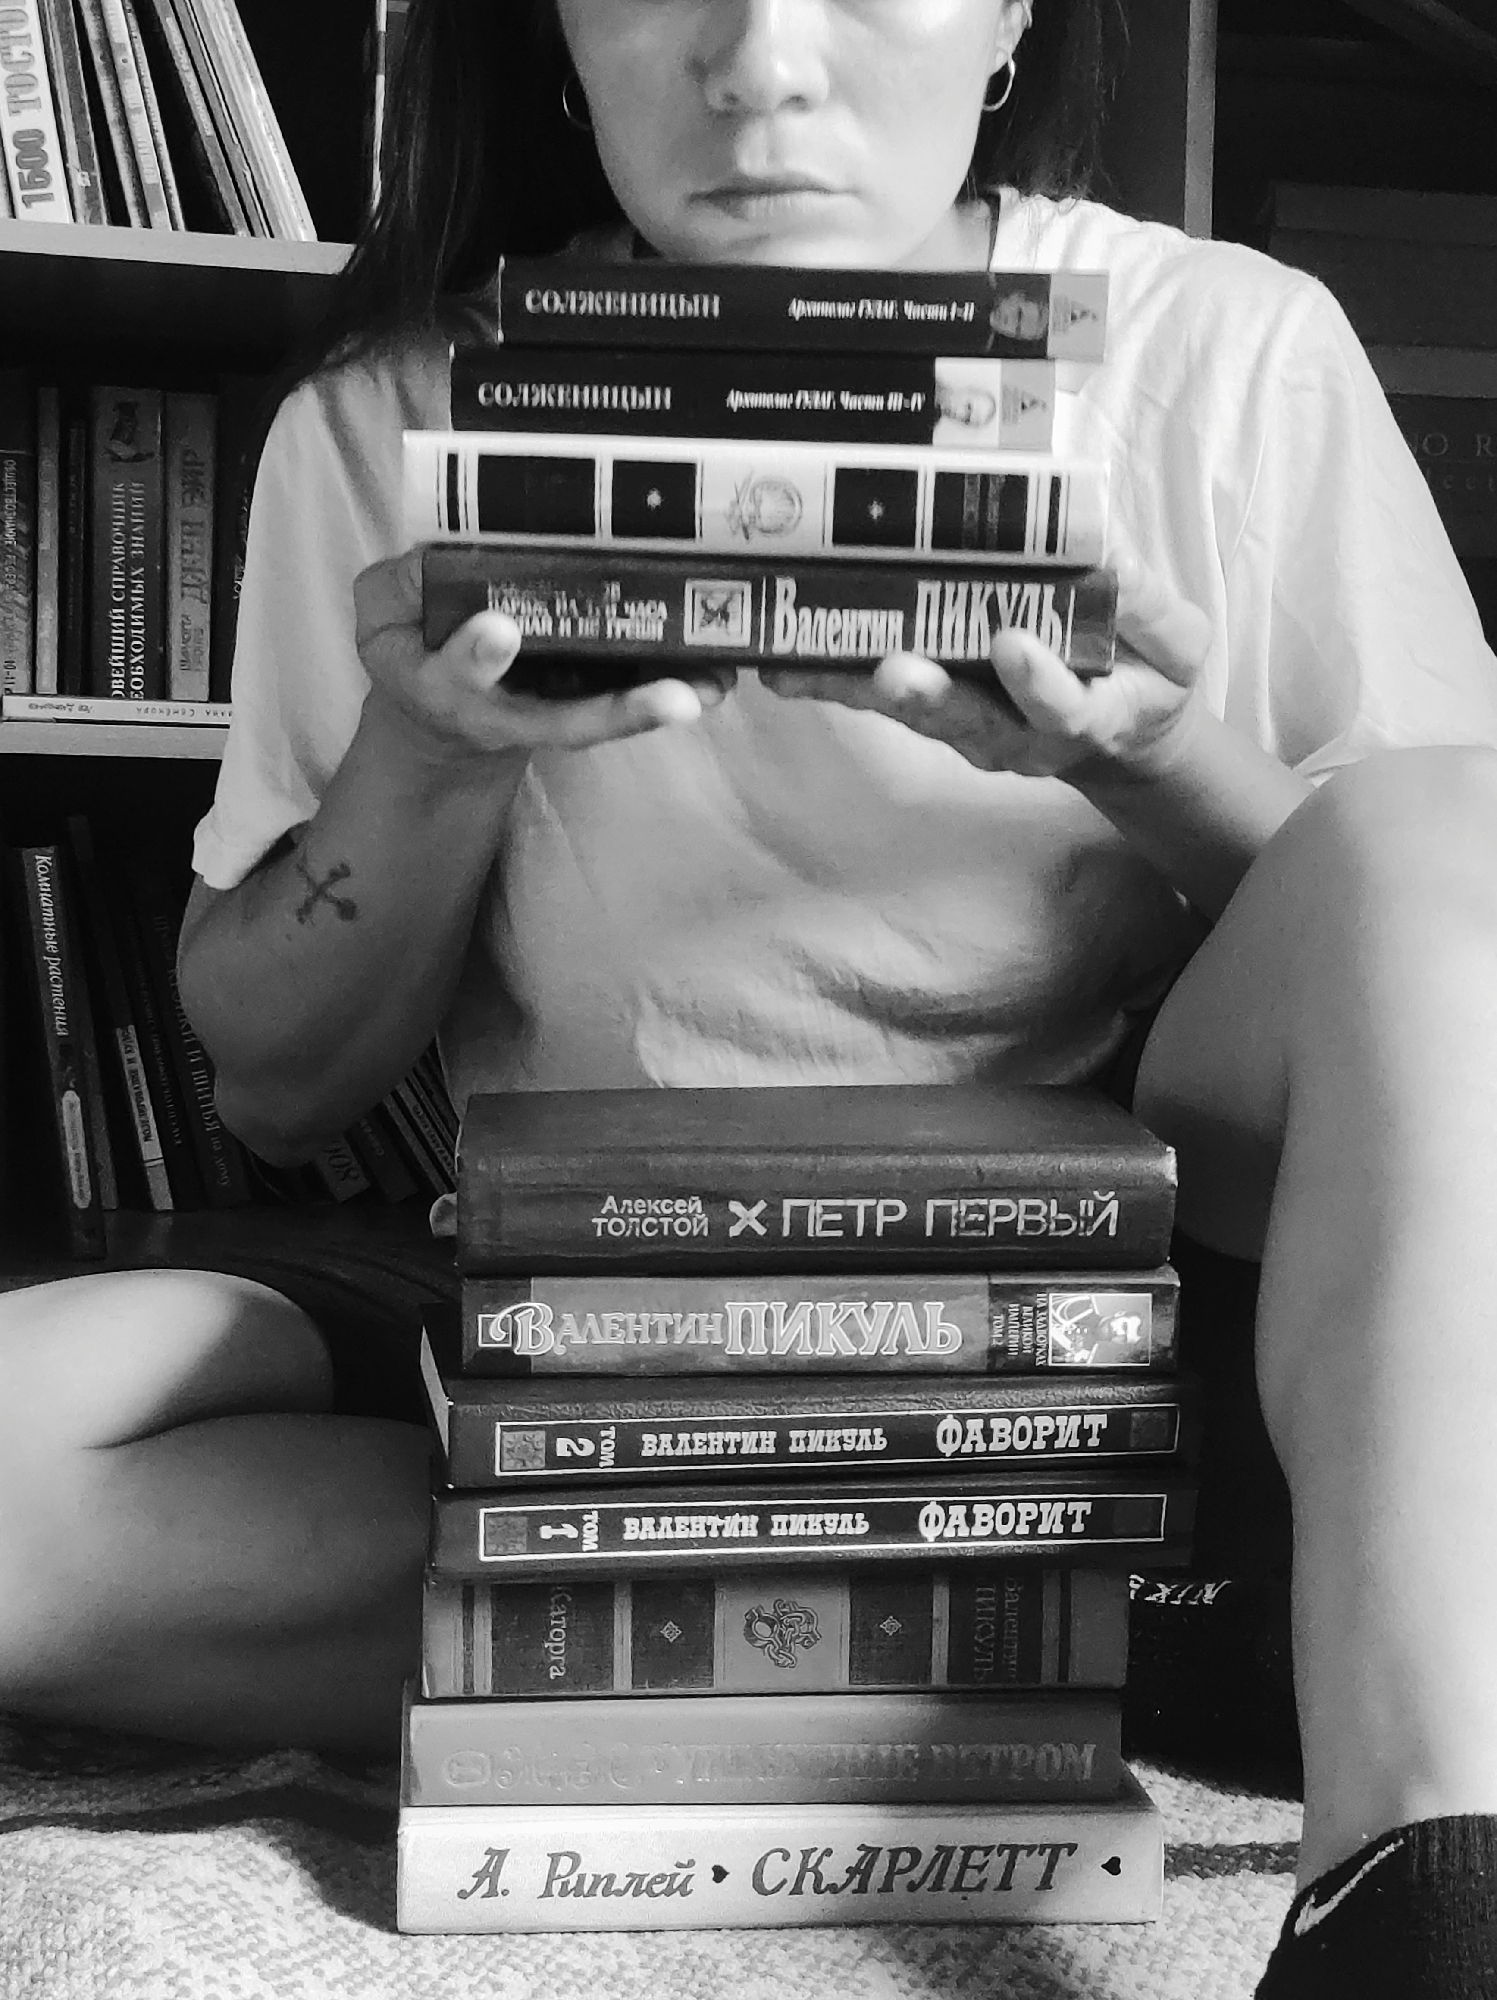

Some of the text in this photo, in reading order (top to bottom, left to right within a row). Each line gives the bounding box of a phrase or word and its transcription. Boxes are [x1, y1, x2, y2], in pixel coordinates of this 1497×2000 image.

[0, 0, 55, 209] 1500 ТОСТО
[107, 482, 126, 698] ОВЕЙШИЙ СПРАВОЧНИК
[129, 481, 146, 699] ЕОБХОДИМЫХ ЗНАНИЙ
[772, 576, 904, 658] Валентин
[913, 579, 1062, 660] ПИКУЛЬ
[34, 854, 70, 1038] Комнатные растения
[190, 1069, 220, 1132] ШИТЬЯ
[592, 1213, 708, 1237] ТОЛСТОЙ
[600, 1195, 703, 1215] Алексей
[782, 1190, 1119, 1237] ПЕТР ПЕРВЫЙ
[724, 1301, 963, 1356] ПИКУЛЬ
[556, 1425, 616, 1468] ТОМ 2
[641, 1414, 1108, 1457] ВАЛЕНТИН ПИКУЛЬ ФАВОРИТ
[539, 1510, 599, 1552] ТОМ 1
[623, 1500, 1092, 1542] ВАЛЕНТИН ПИКУЛЬ ФАВОРИТ
[544, 1584, 572, 1680] Каторга
[456, 1846, 697, 1900] А. Риплей
[752, 1842, 1079, 1897] СКАРЛЕТТ
